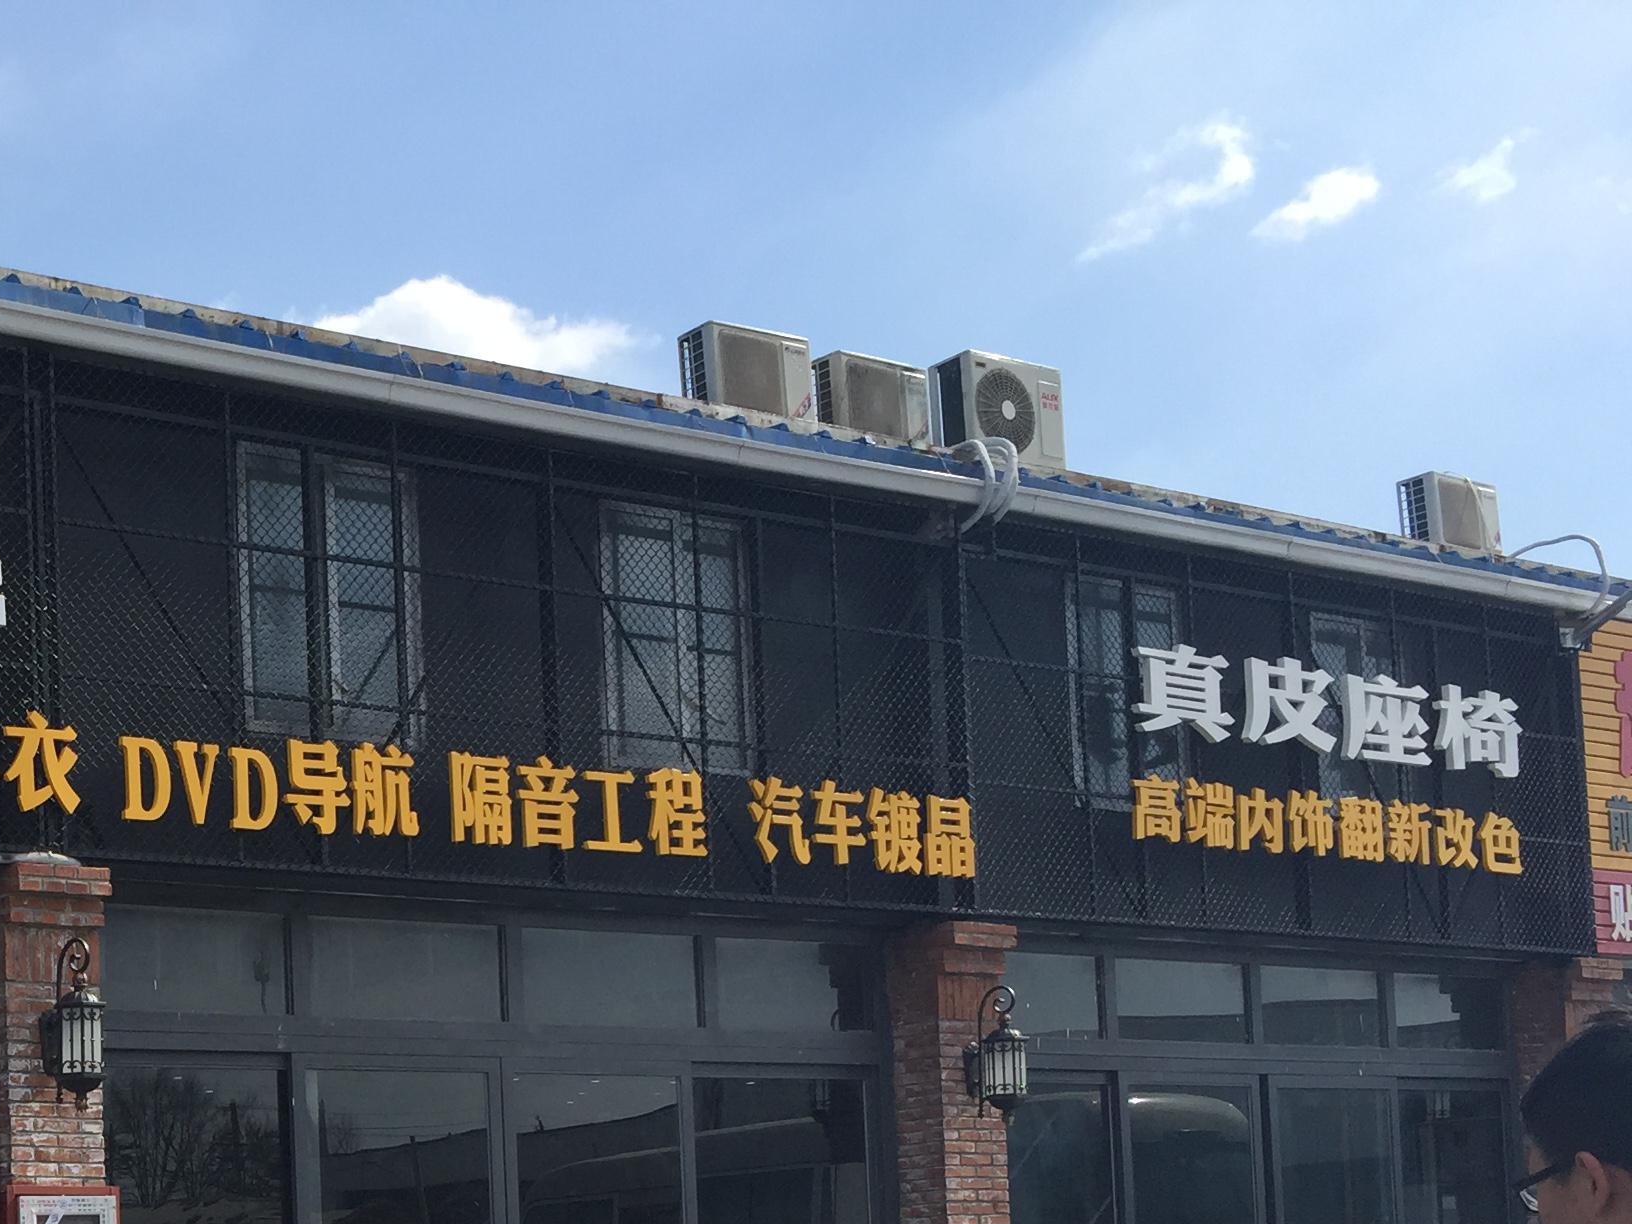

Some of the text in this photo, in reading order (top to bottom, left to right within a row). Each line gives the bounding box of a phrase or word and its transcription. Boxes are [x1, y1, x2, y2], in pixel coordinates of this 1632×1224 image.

[1131, 644, 1524, 778] 真皮座椅
[119, 734, 421, 837] DVD导航
[448, 750, 709, 858] 隔音工程
[748, 776, 976, 878] 汽车镀晶
[1131, 775, 1524, 875] 高端内饰翻新改色
